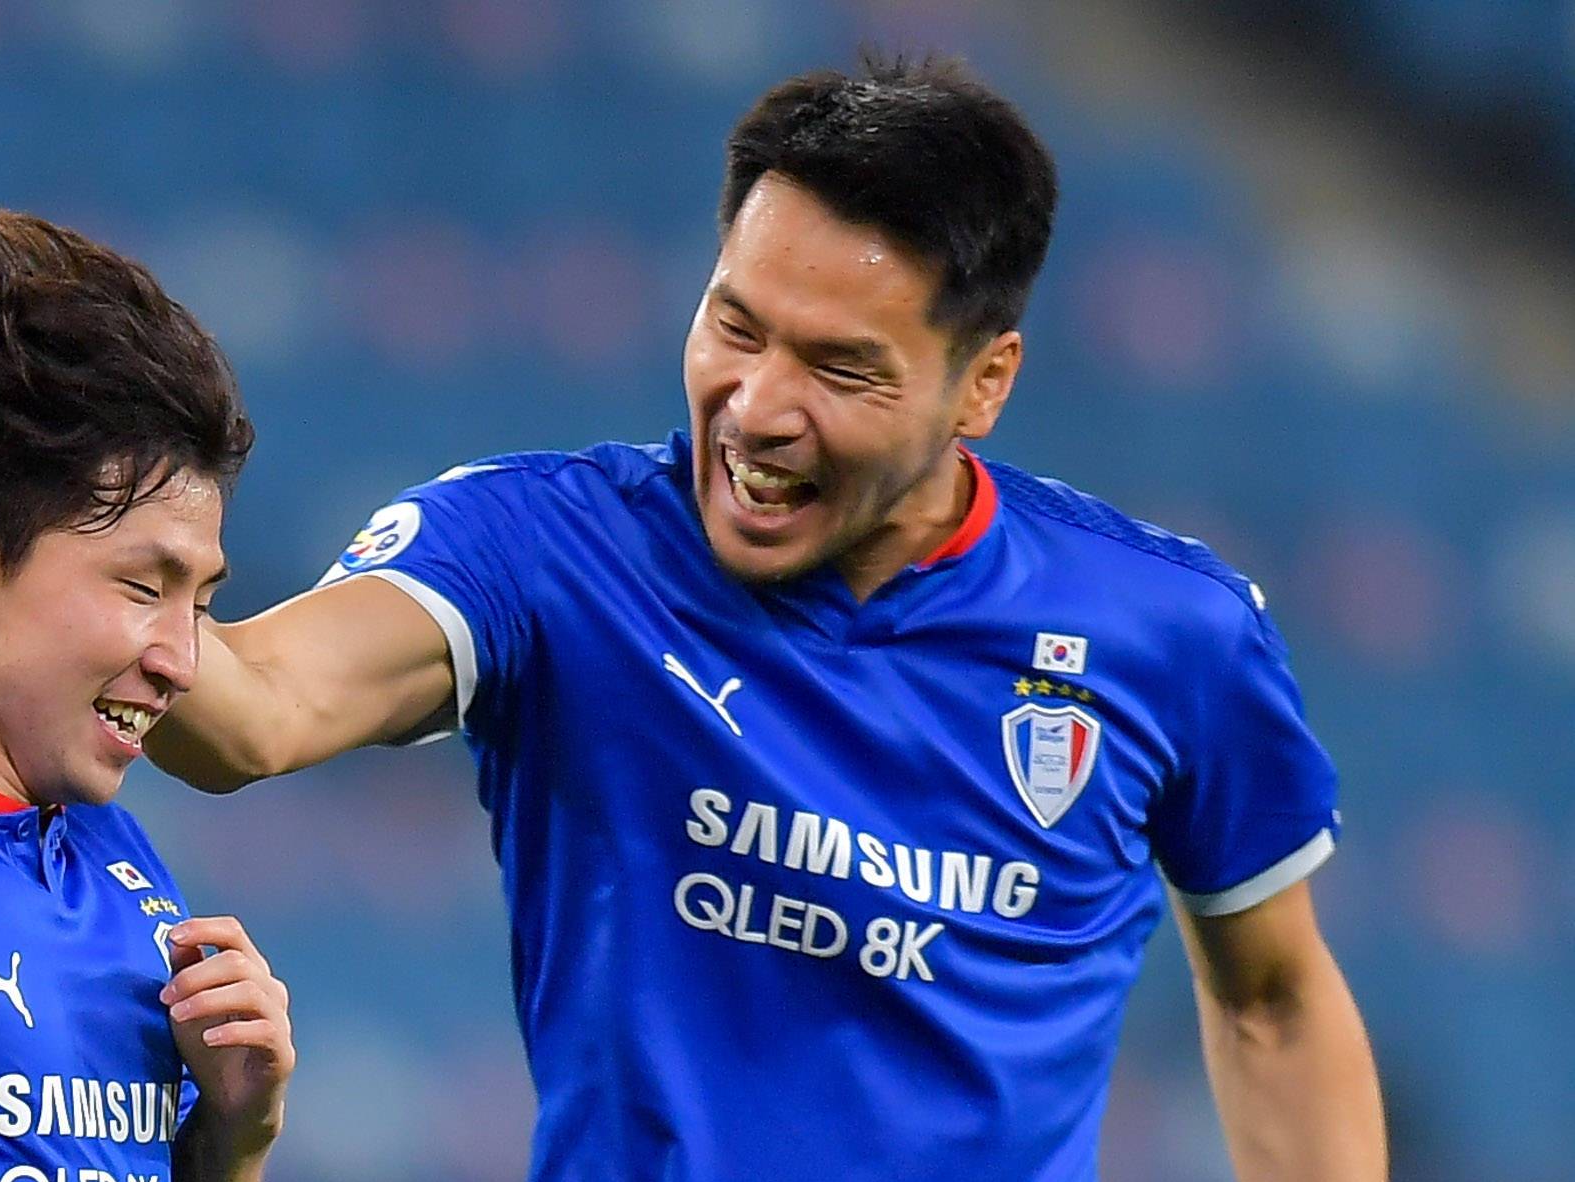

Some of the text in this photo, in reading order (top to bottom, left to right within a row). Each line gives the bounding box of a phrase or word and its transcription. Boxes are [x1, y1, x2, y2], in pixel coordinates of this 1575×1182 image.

[685, 788, 1040, 918] SAMSUNG
[674, 872, 944, 981] QLED 8K
